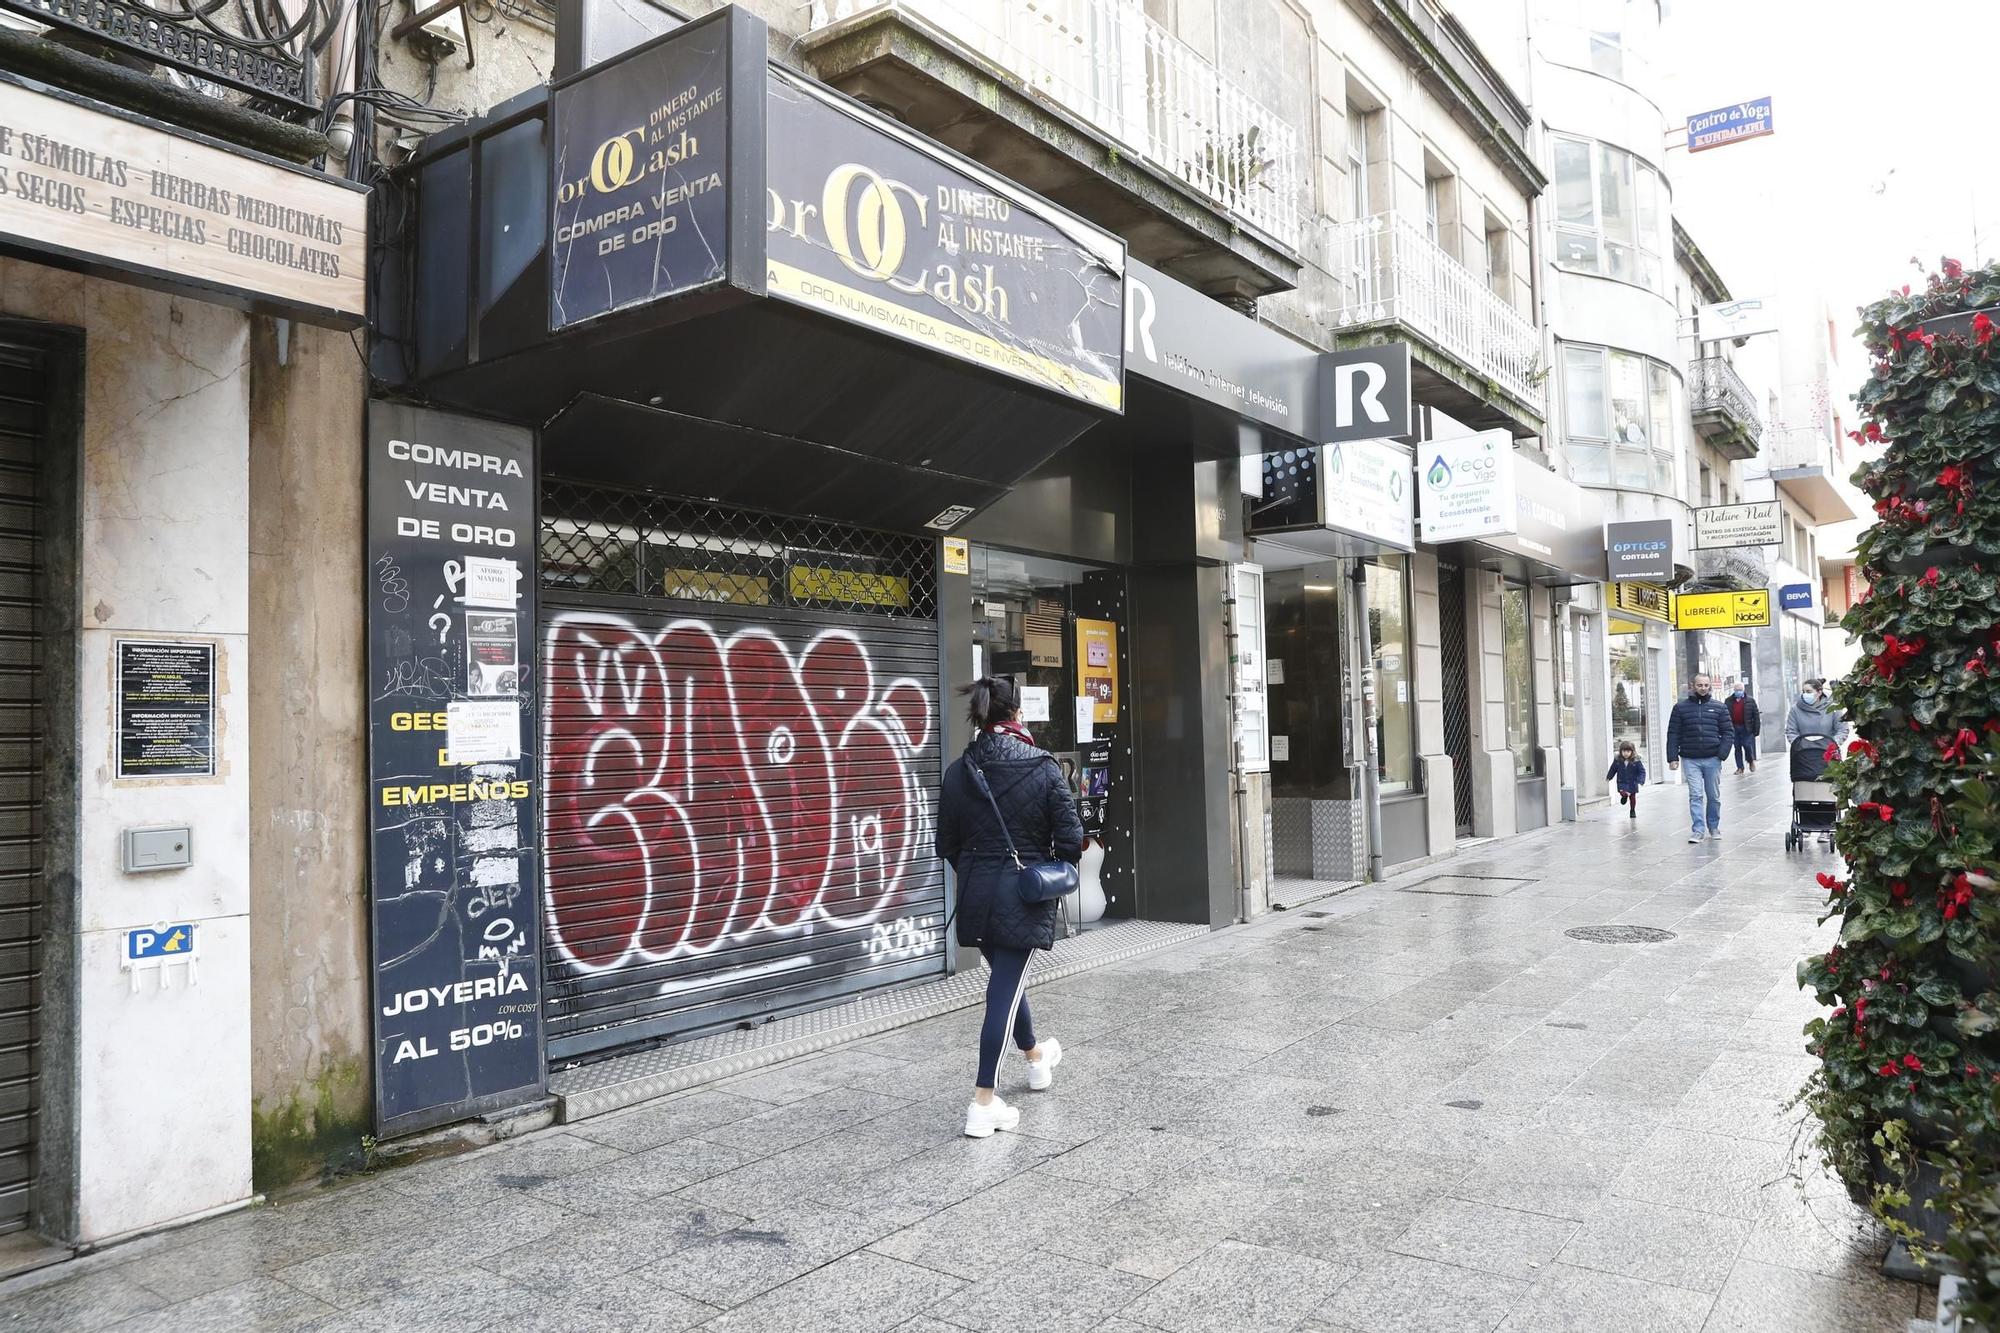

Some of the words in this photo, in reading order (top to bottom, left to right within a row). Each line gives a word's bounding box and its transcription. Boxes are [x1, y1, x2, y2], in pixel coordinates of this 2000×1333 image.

[650, 85, 697, 128] DINERO
[651, 129, 665, 147] AL
[667, 87, 723, 136] INSTANTE
[1688, 111, 1728, 135] Centro
[1729, 110, 1741, 121] de
[1739, 103, 1771, 120] Yoga
[21, 133, 128, 189] SÉMOLAS
[151, 170, 231, 216] HERBAS
[236, 194, 343, 247] MEDICINÁIS
[557, 201, 646, 244] COMPRA
[651, 172, 723, 211] VENTA
[937, 185, 1010, 223] DINERO
[16, 171, 87, 215] SECOS
[110, 196, 206, 246] ESPECIAS
[227, 227, 340, 280] CHOCOLATES
[599, 233, 625, 257] DE
[632, 216, 677, 245] ORO
[937, 223, 960, 251] AL
[965, 225, 1044, 263] INSTANTE
[1126, 274, 1158, 363] R
[944, 330, 972, 351] ORO
[974, 342, 991, 357] DE
[1335, 361, 1391, 428] R
[388, 440, 524, 478] COMPRA
[404, 479, 509, 511] VENTA
[1440, 505, 1490, 517] Ecosostenible
[1702, 510, 1740, 523] Nature
[1744, 505, 1773, 519] Nail
[397, 516, 441, 540] DE
[451, 523, 516, 547] ORO
[1685, 606, 1726, 617] LIBRERÍA
[1786, 592, 1810, 600] BBVA
[1735, 611, 1765, 621] Nobel
[382, 777, 529, 806] EMPEÑOS
[136, 933, 155, 955] P
[383, 972, 529, 1017] JOYERÍA
[498, 1005, 516, 1015] LOW
[517, 1003, 538, 1014] COST
[393, 1036, 439, 1064] AL
[450, 1019, 522, 1052] 50%
